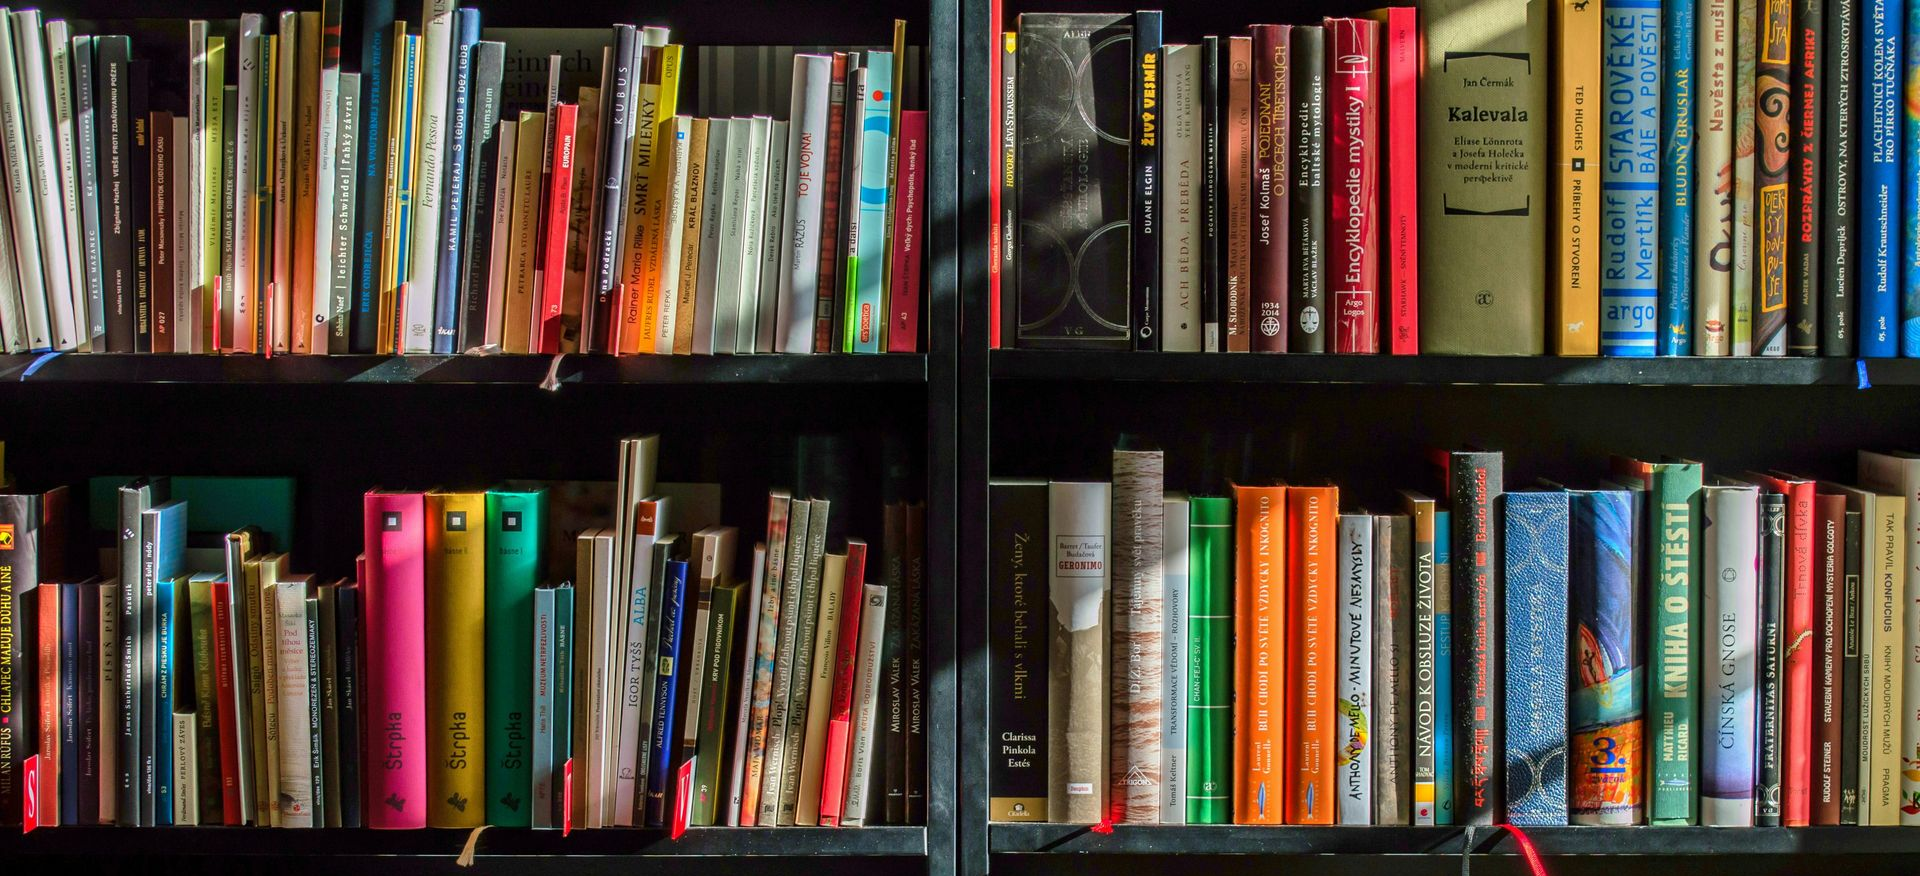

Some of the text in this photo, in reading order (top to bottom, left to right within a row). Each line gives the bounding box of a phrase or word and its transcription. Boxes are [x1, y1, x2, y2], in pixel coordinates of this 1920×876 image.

[456, 74, 466, 92] bez
[458, 44, 468, 69] teba
[1463, 76, 1514, 89] Jan Čermák
[1800, 28, 1816, 138] ČIERNEJ AFRIKY
[1874, 38, 1885, 80] KOLEM
[454, 108, 464, 140] tebou
[1448, 106, 1528, 122] Kalevala
[1606, 14, 1635, 174] STAROVĚKÉ
[1640, 14, 1657, 174] BÁJE POVĚSTI
[1710, 63, 1724, 132] Nevěsta
[110, 62, 122, 235] Zbigniew Machej VERŠE PROTI POÉZIE
[422, 114, 438, 208] Fernando Pessoa
[562, 135, 572, 168] EUROPAIN
[1141, 52, 1157, 234] DUANE ELGIN ŽIVÝ VESMÍR
[1299, 102, 1312, 188] Encyklopedie
[1312, 76, 1324, 188] baltské mytologie
[1454, 136, 1523, 146] Eliase Lönnrota
[1459, 148, 1524, 159] Josefa Holečka
[1674, 68, 1688, 208] BLUDNÝ BRUSLAŘ
[1884, 99, 1895, 163] PRO PÍRKO
[225, 180, 233, 209] OBRÁZEK
[450, 163, 461, 210] PETERAJ
[602, 66, 628, 276] Podracká KUBUS
[799, 132, 813, 198] TO JE VOJNA!
[1006, 152, 1014, 188] HOVORY
[1346, 96, 1365, 284] Encyklopedie mystiky
[1453, 160, 1529, 170] moderní kritické
[1464, 173, 1514, 184] perspektivě
[1572, 86, 1584, 290] TED HUGHES STVORENÍ
[336, 96, 352, 313] Naef leichter Schwindel závrat
[448, 216, 458, 250] KAMIL
[628, 98, 656, 324] Rainer Maria Rilke SMRŤ MILENKY
[1259, 168, 1270, 246] Josef Kolmaš
[1836, 140, 1848, 298] Lucien NA
[90, 230, 98, 274] MAZANEC
[1606, 198, 1626, 280] Rudolf
[1636, 196, 1652, 280] Mertlík
[1877, 184, 1889, 292] Rudolf Krautschneider
[158, 312, 166, 324] 027
[361, 291, 370, 312] ERIK
[647, 278, 656, 304] RUDEL
[1180, 281, 1190, 310] ACH
[1608, 305, 1654, 328] argo
[1058, 561, 1102, 570] GERONIMO
[1130, 500, 1144, 662] Bor pravěku
[1883, 512, 1894, 632] TAK KONFUCIUS
[827, 590, 836, 620] BALADY
[1257, 496, 1270, 706] CHODÍ PO VŽDYCKY INKOGNITO
[1306, 496, 1318, 706] CHODÍ PO VŽDYCKY INKOGNITO
[1660, 503, 1690, 698] KNIHA O ŠTĚSTÍ
[104, 594, 112, 682] PÍSEŇ PÍSNÍ
[628, 587, 646, 707] IGOR TYŠŠ ALBA
[712, 654, 720, 668] POD
[1416, 552, 1432, 757] NÁVOD K OBSLUZE ŽIVOTA
[1824, 520, 1835, 802] RUDOLF STEINER KAMENY PRO MYSTERIA GOLGOTY
[1882, 645, 1891, 674] KNIHY
[0, 666, 11, 713] CHLAPEC
[124, 636, 132, 710] Sutherland-Smith
[890, 657, 901, 733] MIROSLAV VÁLEK
[910, 658, 920, 734] MIROSLAV VÁLEK
[1170, 674, 1178, 735] TRANSFORMACE
[1718, 613, 1736, 749] ČÍNSKÁ GNOSE
[1765, 622, 1776, 768] FRATERNITAS SATURNI
[382, 712, 406, 770] Štrpka
[444, 712, 470, 770] Štrpka
[500, 712, 526, 770] Štrpka
[656, 681, 668, 748] ALFRED TENNYSON
[785, 700, 804, 794] Ivan Wernisch Plop!
[1001, 732, 1036, 742] Clarissa
[1348, 694, 1361, 800] ANTHONY MELLO
[1663, 712, 1674, 762] MATTHIEU
[1678, 723, 1688, 762] RICARD
[178, 746, 186, 780] PERLOVÝ
[766, 700, 785, 795] Ivan Wernisch Plop!
[1002, 746, 1036, 755] Pinkola
[1008, 758, 1030, 768] Estés
[1169, 784, 1177, 807] Tomáš
[1882, 768, 1890, 806] PRAGMA
